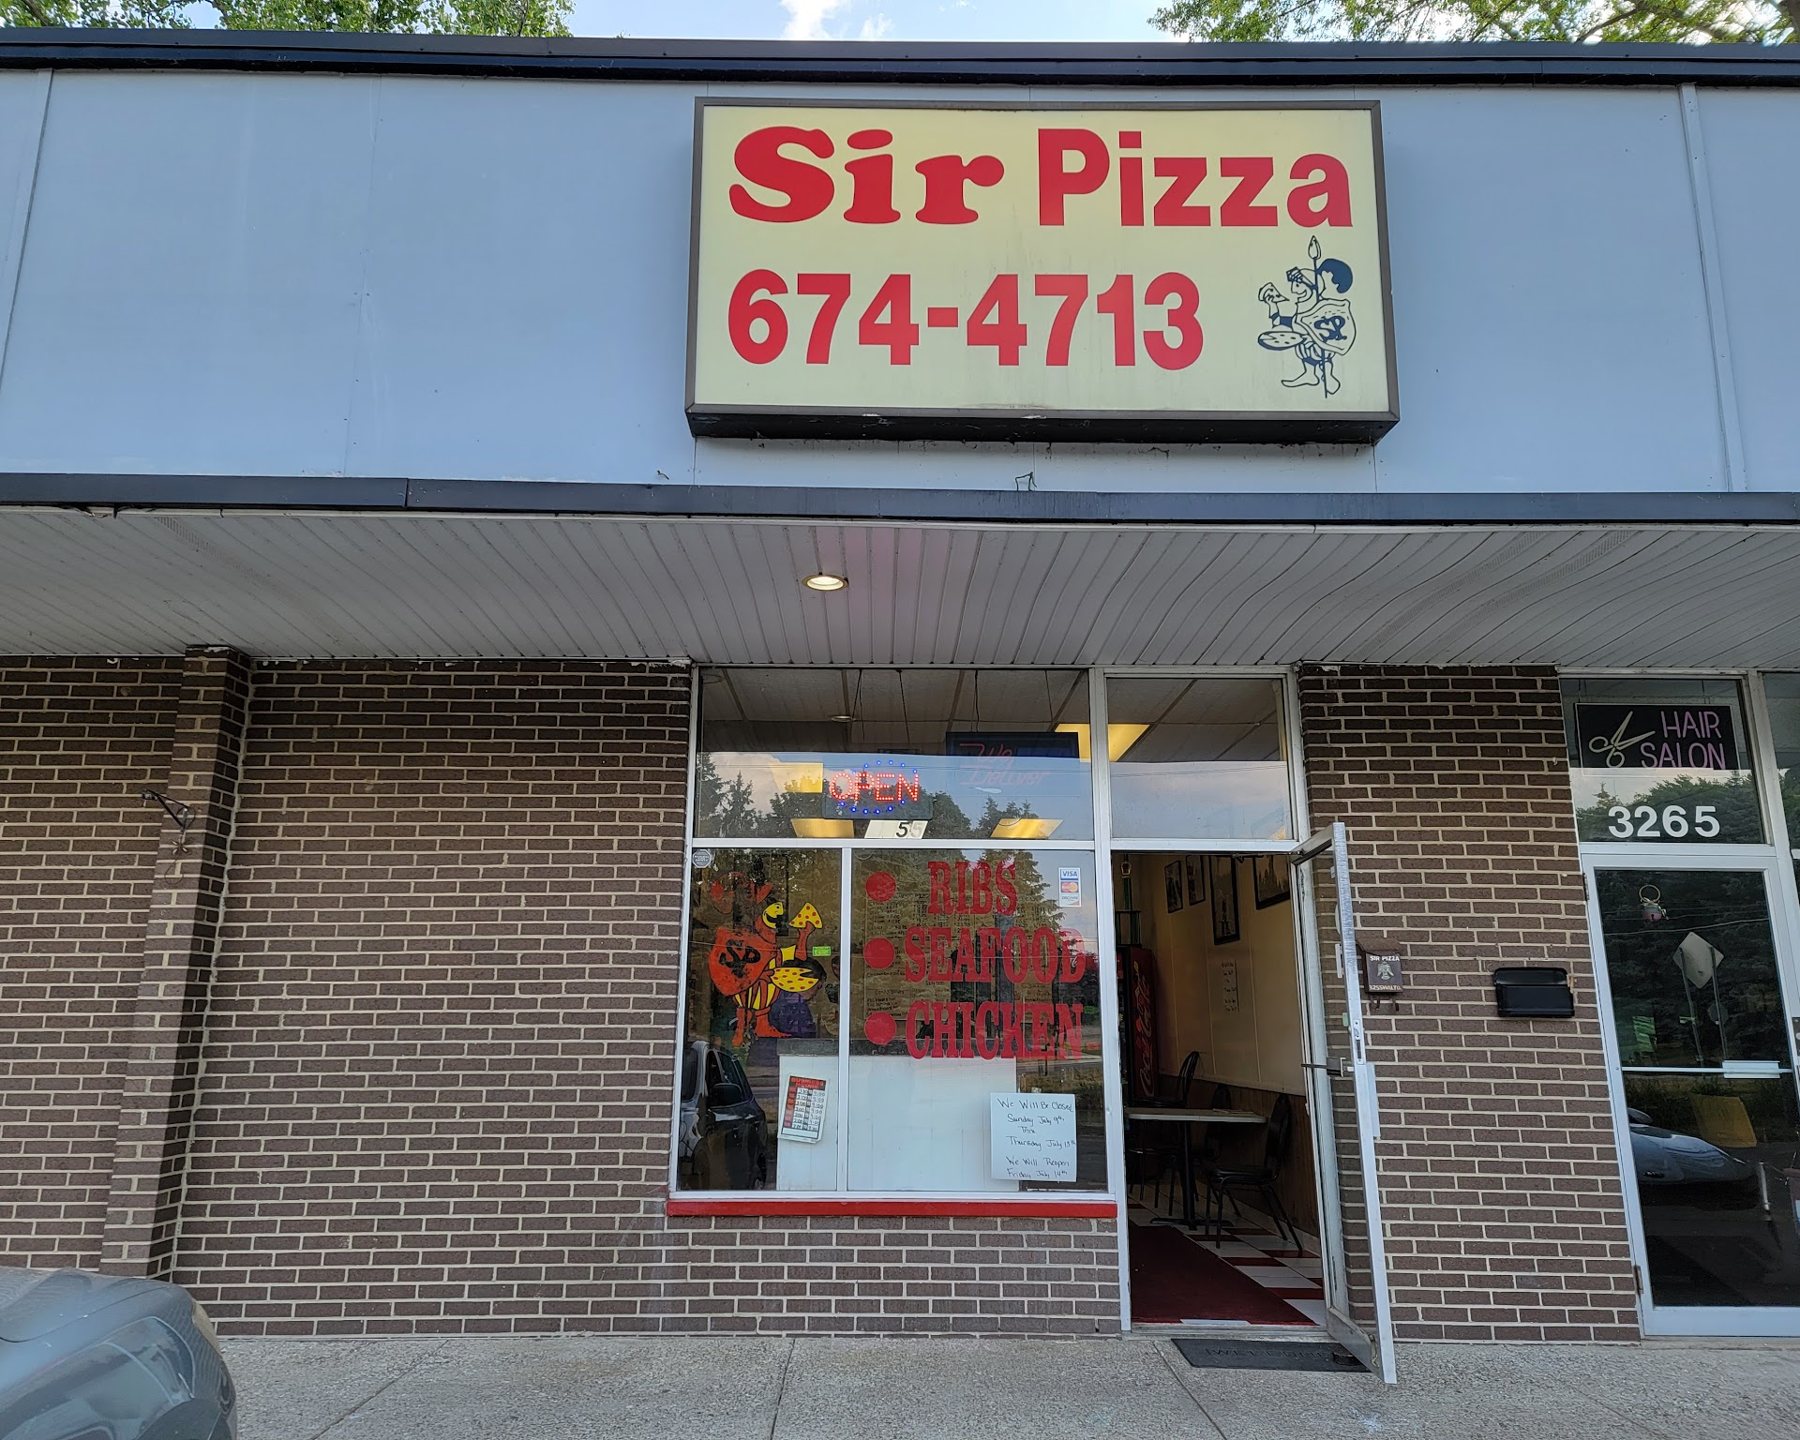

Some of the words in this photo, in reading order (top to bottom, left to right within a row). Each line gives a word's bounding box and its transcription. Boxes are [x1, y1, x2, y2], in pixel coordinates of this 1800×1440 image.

[728, 125, 1005, 224] Sir
[1038, 128, 1354, 227] Pizza
[728, 268, 1204, 370] 674-4713
[1661, 711, 1722, 739] HAIR
[1640, 742, 1727, 770] SALON
[830, 771, 920, 802] OPEN
[1608, 804, 1721, 839] 3265
[927, 860, 1019, 917] RIBS
[904, 926, 1086, 985] SEAFOOD
[905, 1001, 1084, 1061] CHICKEN
[997, 1097, 1014, 1108] We
[1019, 1099, 1039, 1110] Will
[1007, 1113, 1034, 1127] Sunday
